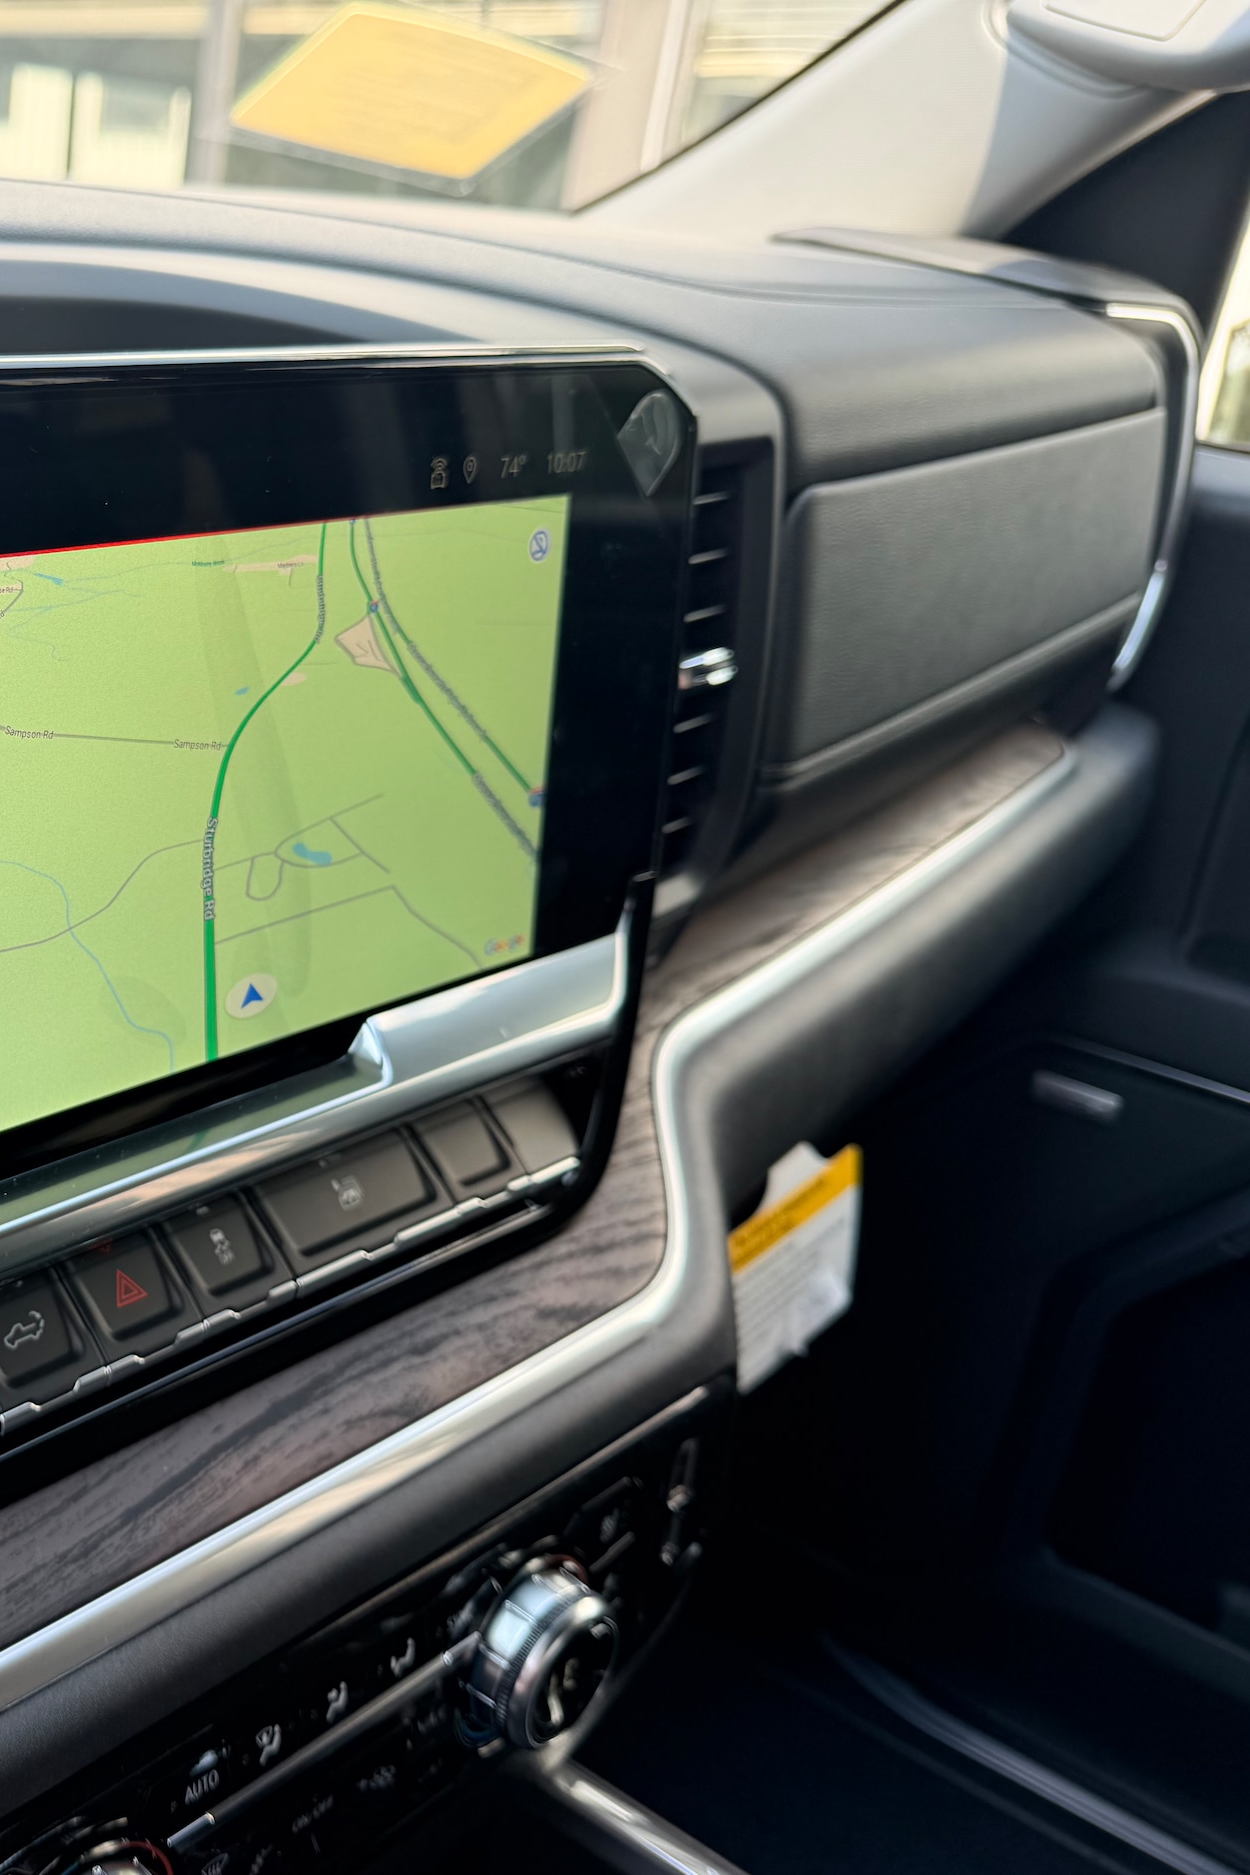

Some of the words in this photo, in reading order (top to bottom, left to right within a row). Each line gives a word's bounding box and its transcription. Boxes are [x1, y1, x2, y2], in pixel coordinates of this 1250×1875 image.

[501, 455, 527, 478] 74°
[547, 451, 587, 475] 10:07
[5, 586, 14, 594] Rd
[4, 725, 41, 740] Sampson
[43, 730, 54, 740] Rd
[173, 738, 210, 751] Sampson
[211, 740, 222, 751] Rd
[200, 817, 218, 898] Sturbridge
[204, 899, 216, 920] Rd
[184, 1769, 220, 1805] AUTO
